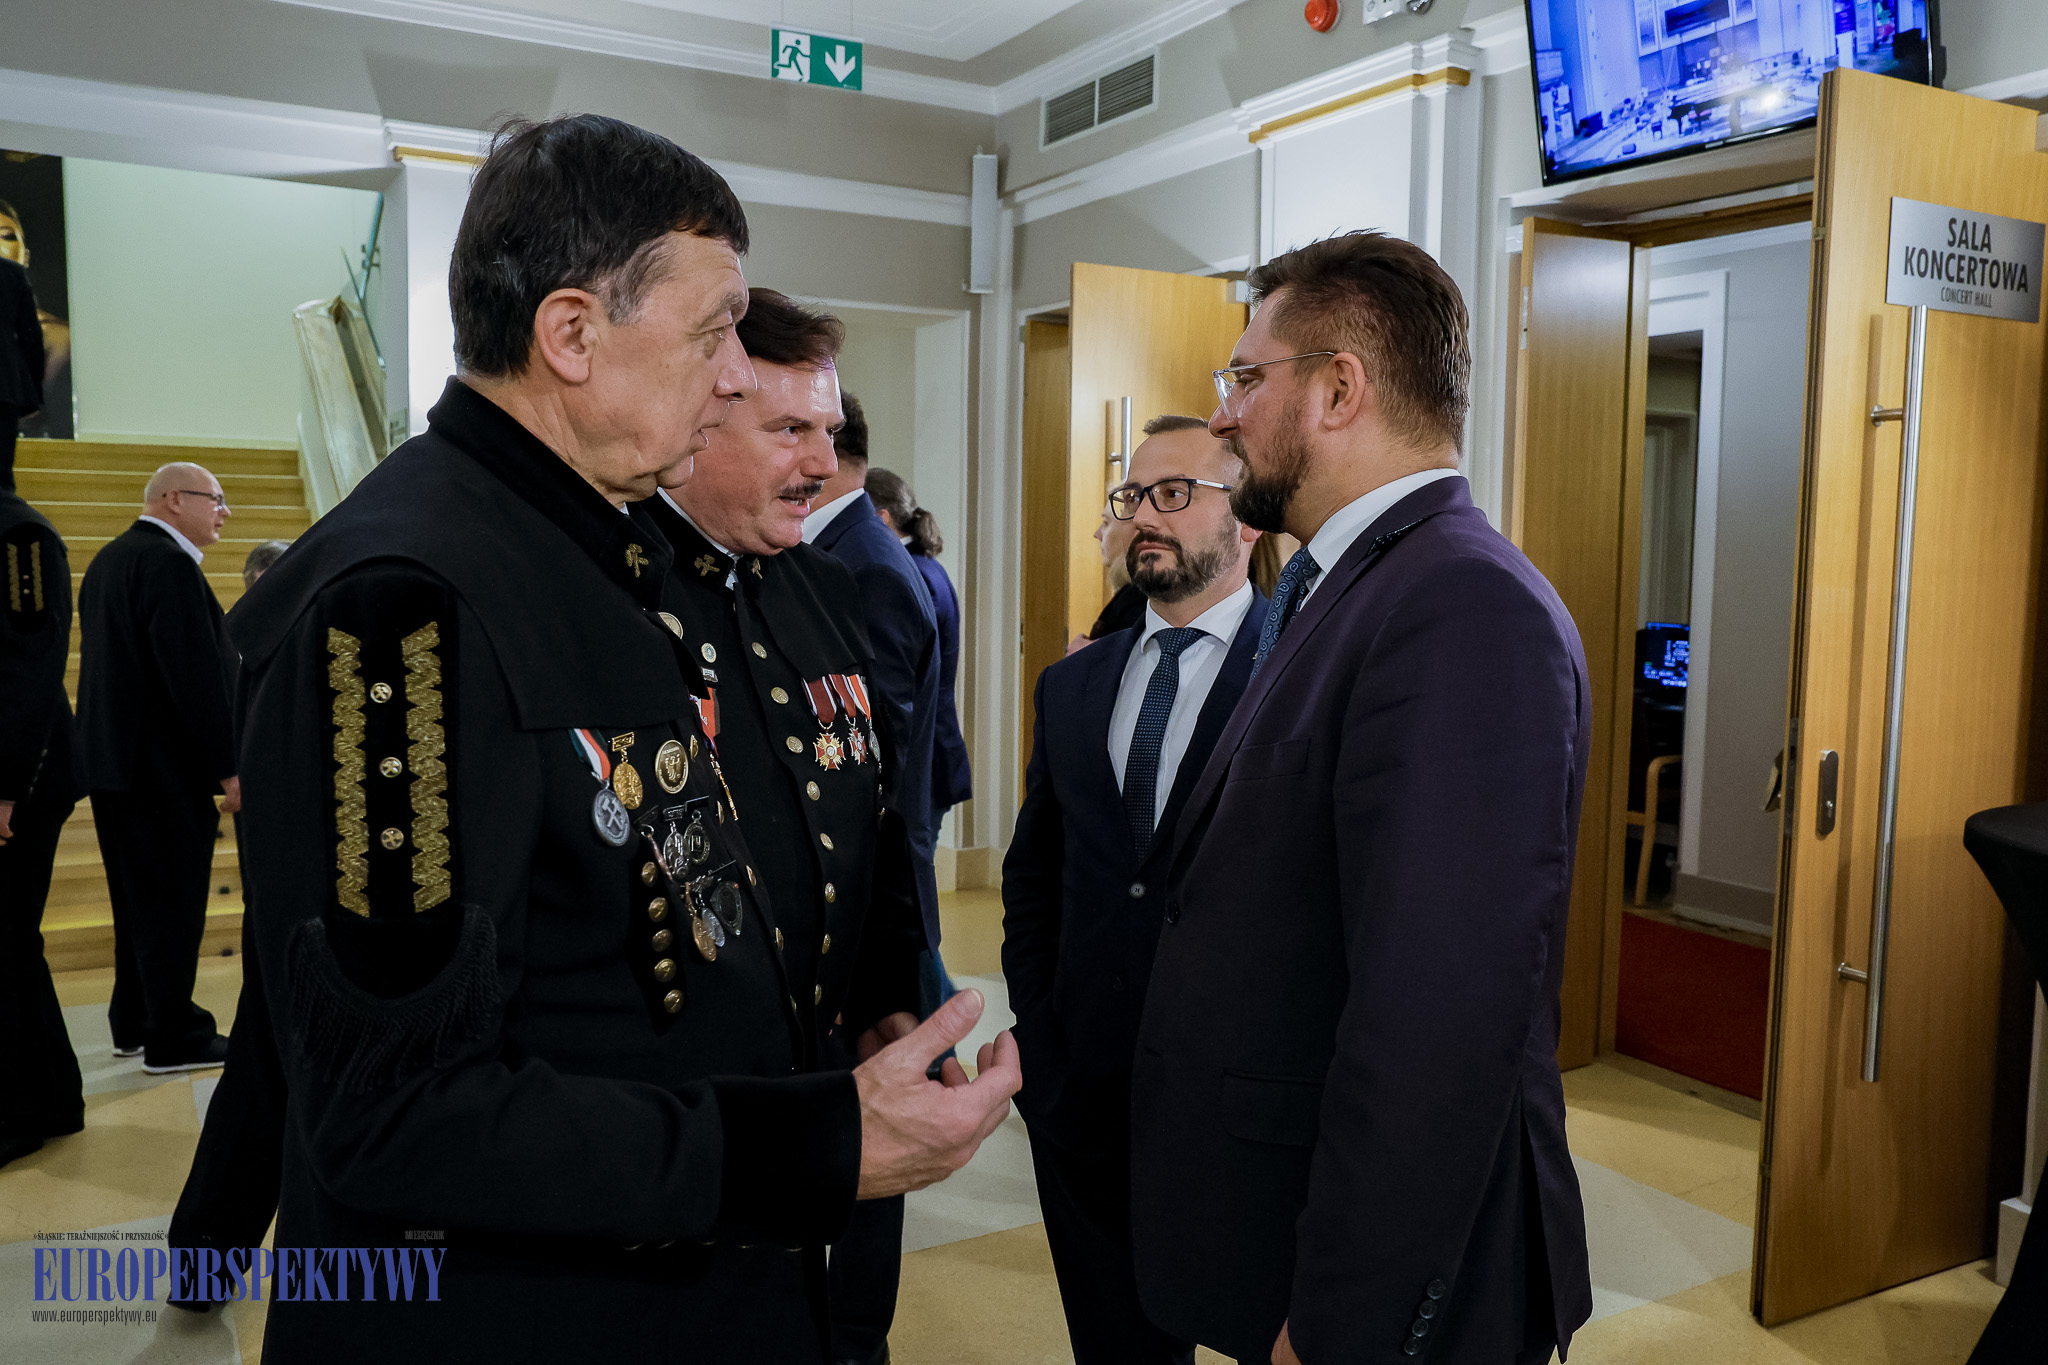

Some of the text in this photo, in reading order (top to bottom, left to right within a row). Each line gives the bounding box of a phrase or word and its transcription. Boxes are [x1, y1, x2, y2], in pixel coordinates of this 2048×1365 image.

[1947, 217, 1992, 253] SALA
[1903, 245, 2029, 293] KONCERTOWA
[1940, 286, 1992, 308] CONCERT HALL
